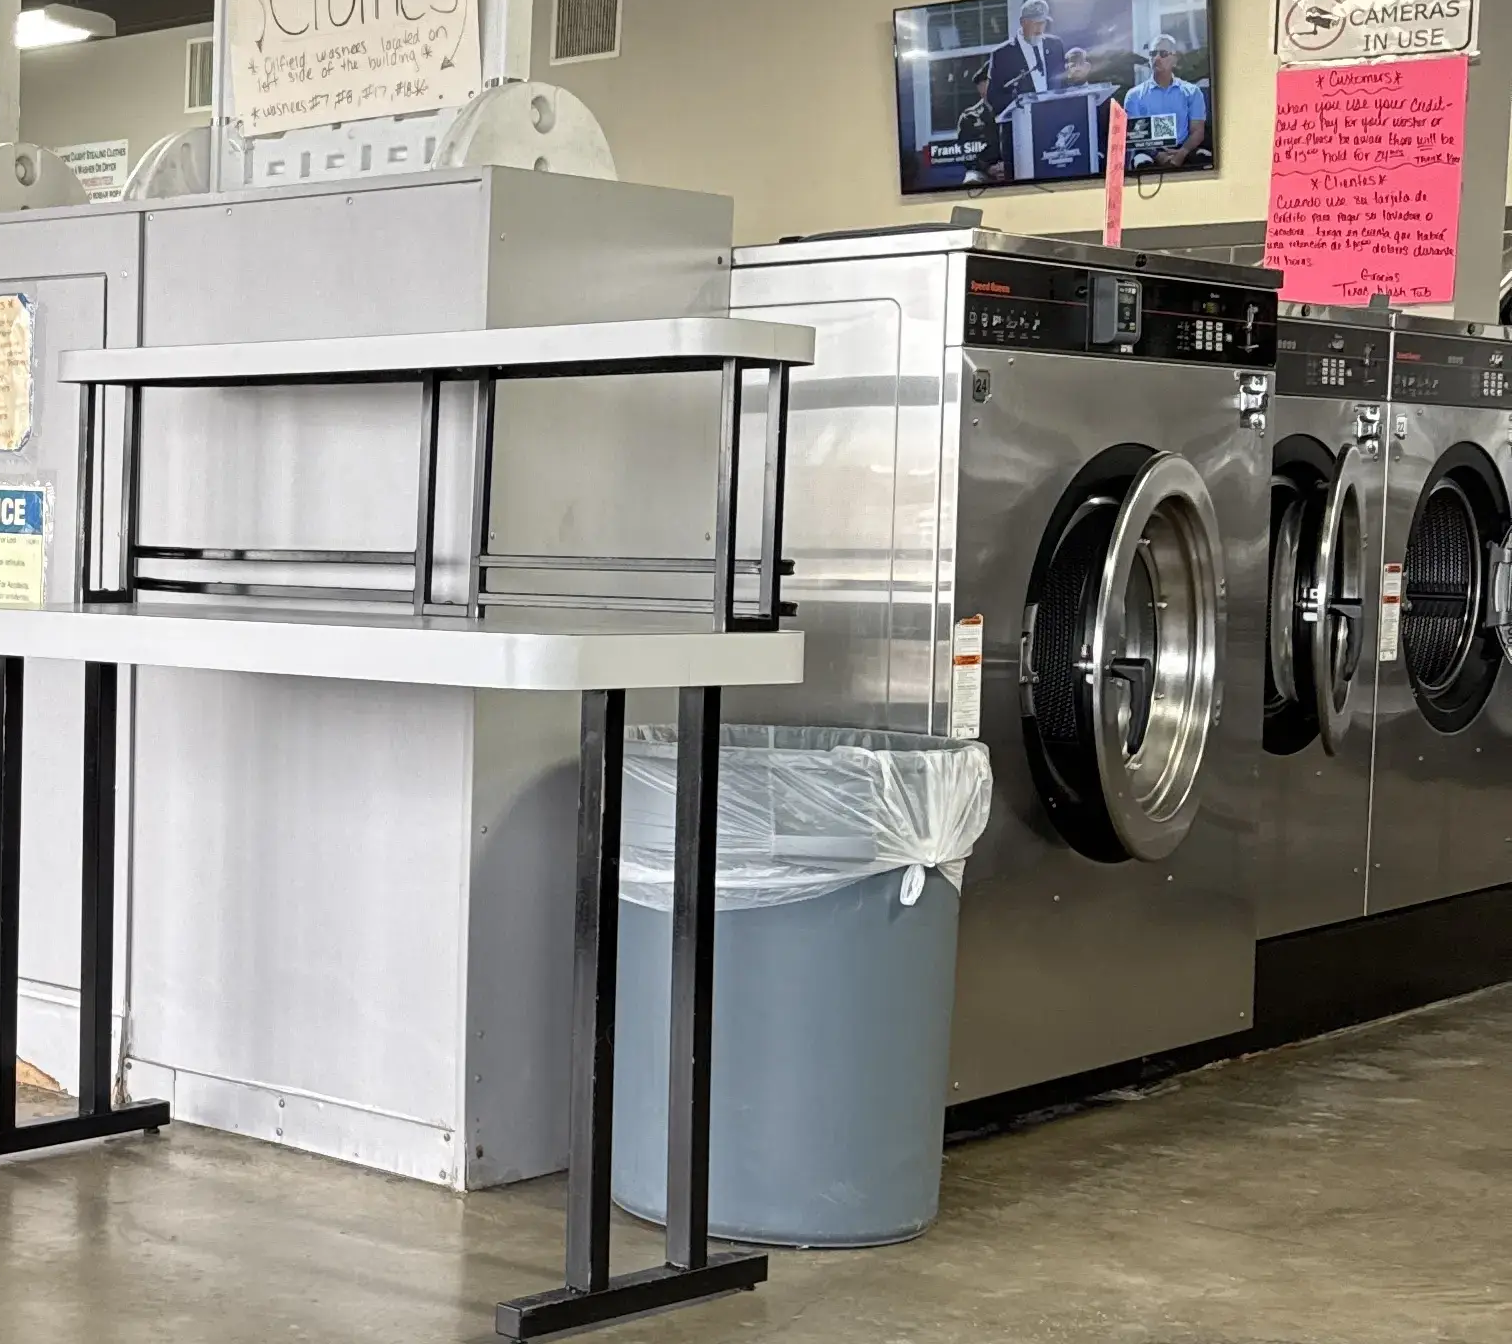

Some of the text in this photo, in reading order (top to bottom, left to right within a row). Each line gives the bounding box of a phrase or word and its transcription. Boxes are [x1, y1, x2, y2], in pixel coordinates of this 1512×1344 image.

[1348, 0, 1461, 27] CAMERAS
[381, 27, 420, 51] located
[429, 25, 448, 41] on
[1363, 27, 1444, 52] IN USE
[288, 67, 313, 83] side
[321, 62, 334, 79] of
[341, 57, 358, 71] the
[368, 50, 420, 73] building
[1315, 100, 1340, 120] you
[1374, 98, 1407, 120] your
[1301, 118, 1316, 130] to
[1361, 116, 1389, 133] your
[1339, 132, 1350, 144] be
[1440, 134, 1455, 146] be
[931, 143, 963, 157] Frank
[1273, 150, 1347, 163] a hold
[1324, 174, 1376, 190] Clientes
[1276, 194, 1321, 209] Cuando
[1360, 268, 1400, 283] Gracias
[976, 379, 987, 394] 24
